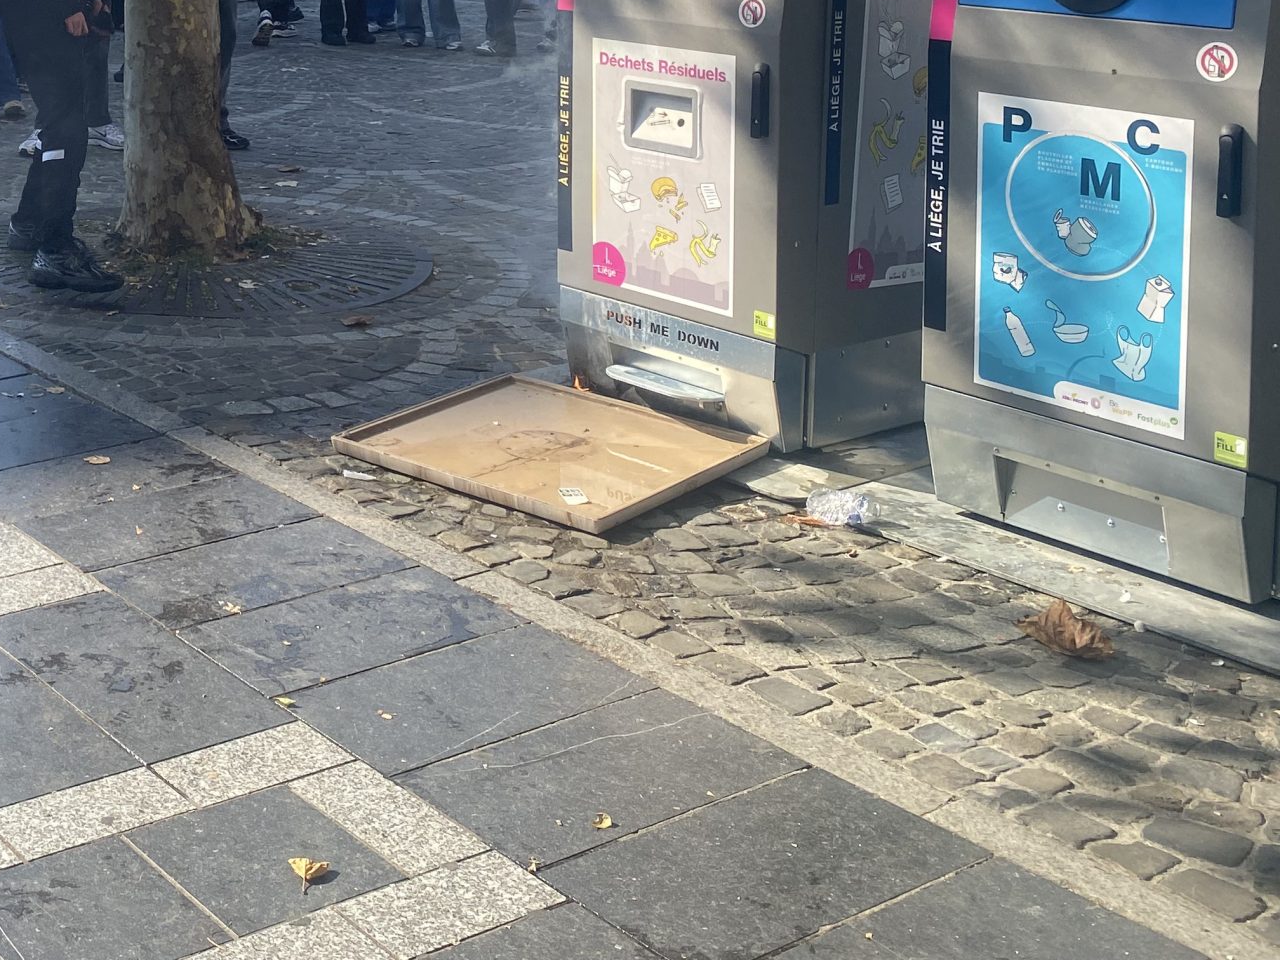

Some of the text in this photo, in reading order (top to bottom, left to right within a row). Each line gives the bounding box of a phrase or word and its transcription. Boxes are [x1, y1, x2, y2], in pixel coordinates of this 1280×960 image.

[832, 10, 843, 45] TRIE
[599, 51, 727, 82] Déchets Résiduels
[832, 47, 842, 66] JE
[559, 75, 570, 107] TRIE
[559, 109, 569, 127] JE
[1002, 105, 1033, 143] P
[558, 131, 571, 174] LIÈGE,
[1126, 118, 1161, 156] C
[927, 119, 946, 253] À LIÈGE, JE TRIE
[1080, 157, 1121, 202] M
[606, 310, 719, 352] PUSH ME DOWN
[755, 319, 768, 328] FILL
[1216, 442, 1236, 453] FILL
